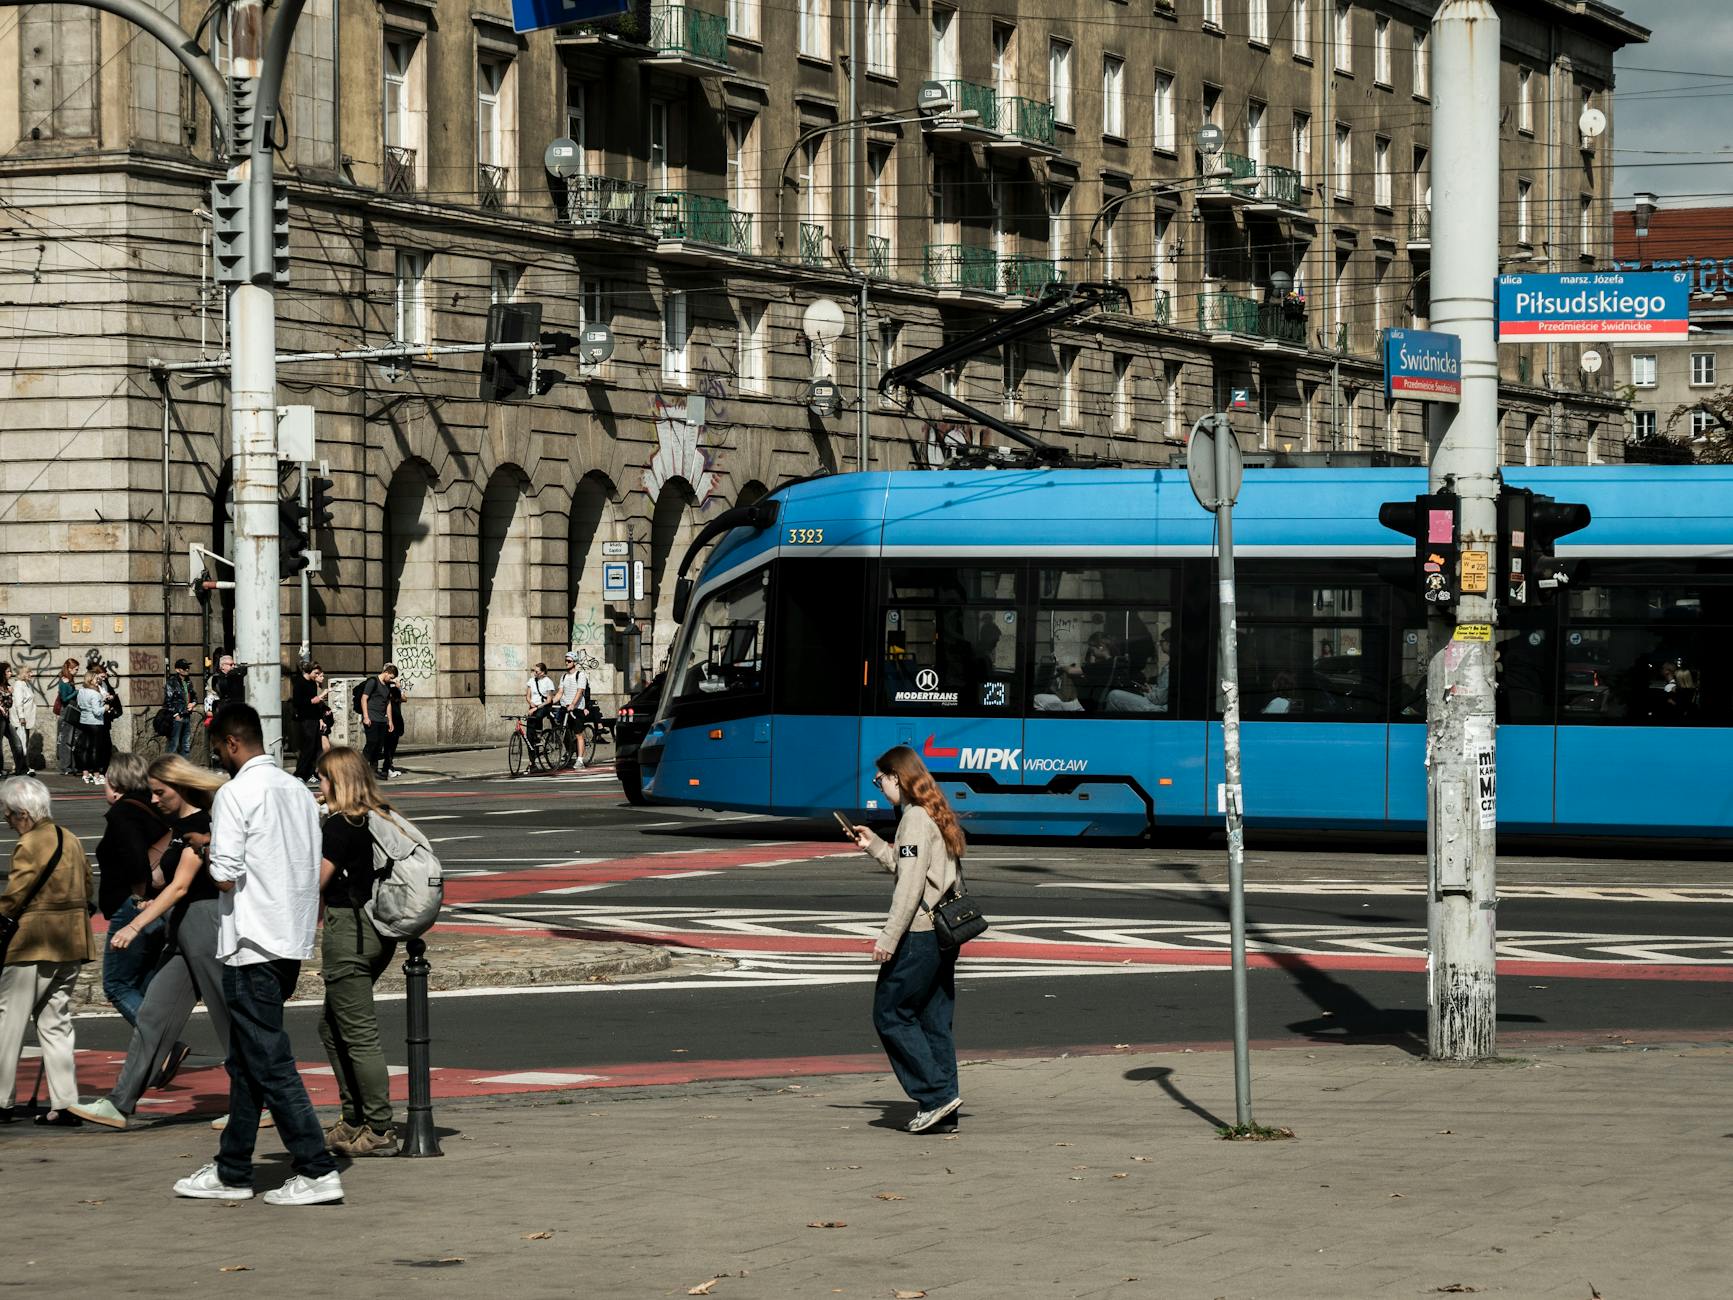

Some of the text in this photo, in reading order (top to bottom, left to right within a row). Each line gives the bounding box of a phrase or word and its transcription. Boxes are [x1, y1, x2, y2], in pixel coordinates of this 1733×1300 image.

[1500, 273, 1686, 285] ulica marsz. Józefa 67
[1516, 290, 1666, 318] Piłsudskiego
[1538, 320, 1653, 331] Przedmieście Świdnickie
[1391, 329, 1404, 339] ulica
[1400, 343, 1457, 374] Świdnicka
[788, 528, 824, 544] 3323
[895, 691, 959, 701] MODERTRANS
[984, 682, 1005, 706] 23
[959, 748, 1089, 772] MPK WROCŁAW
